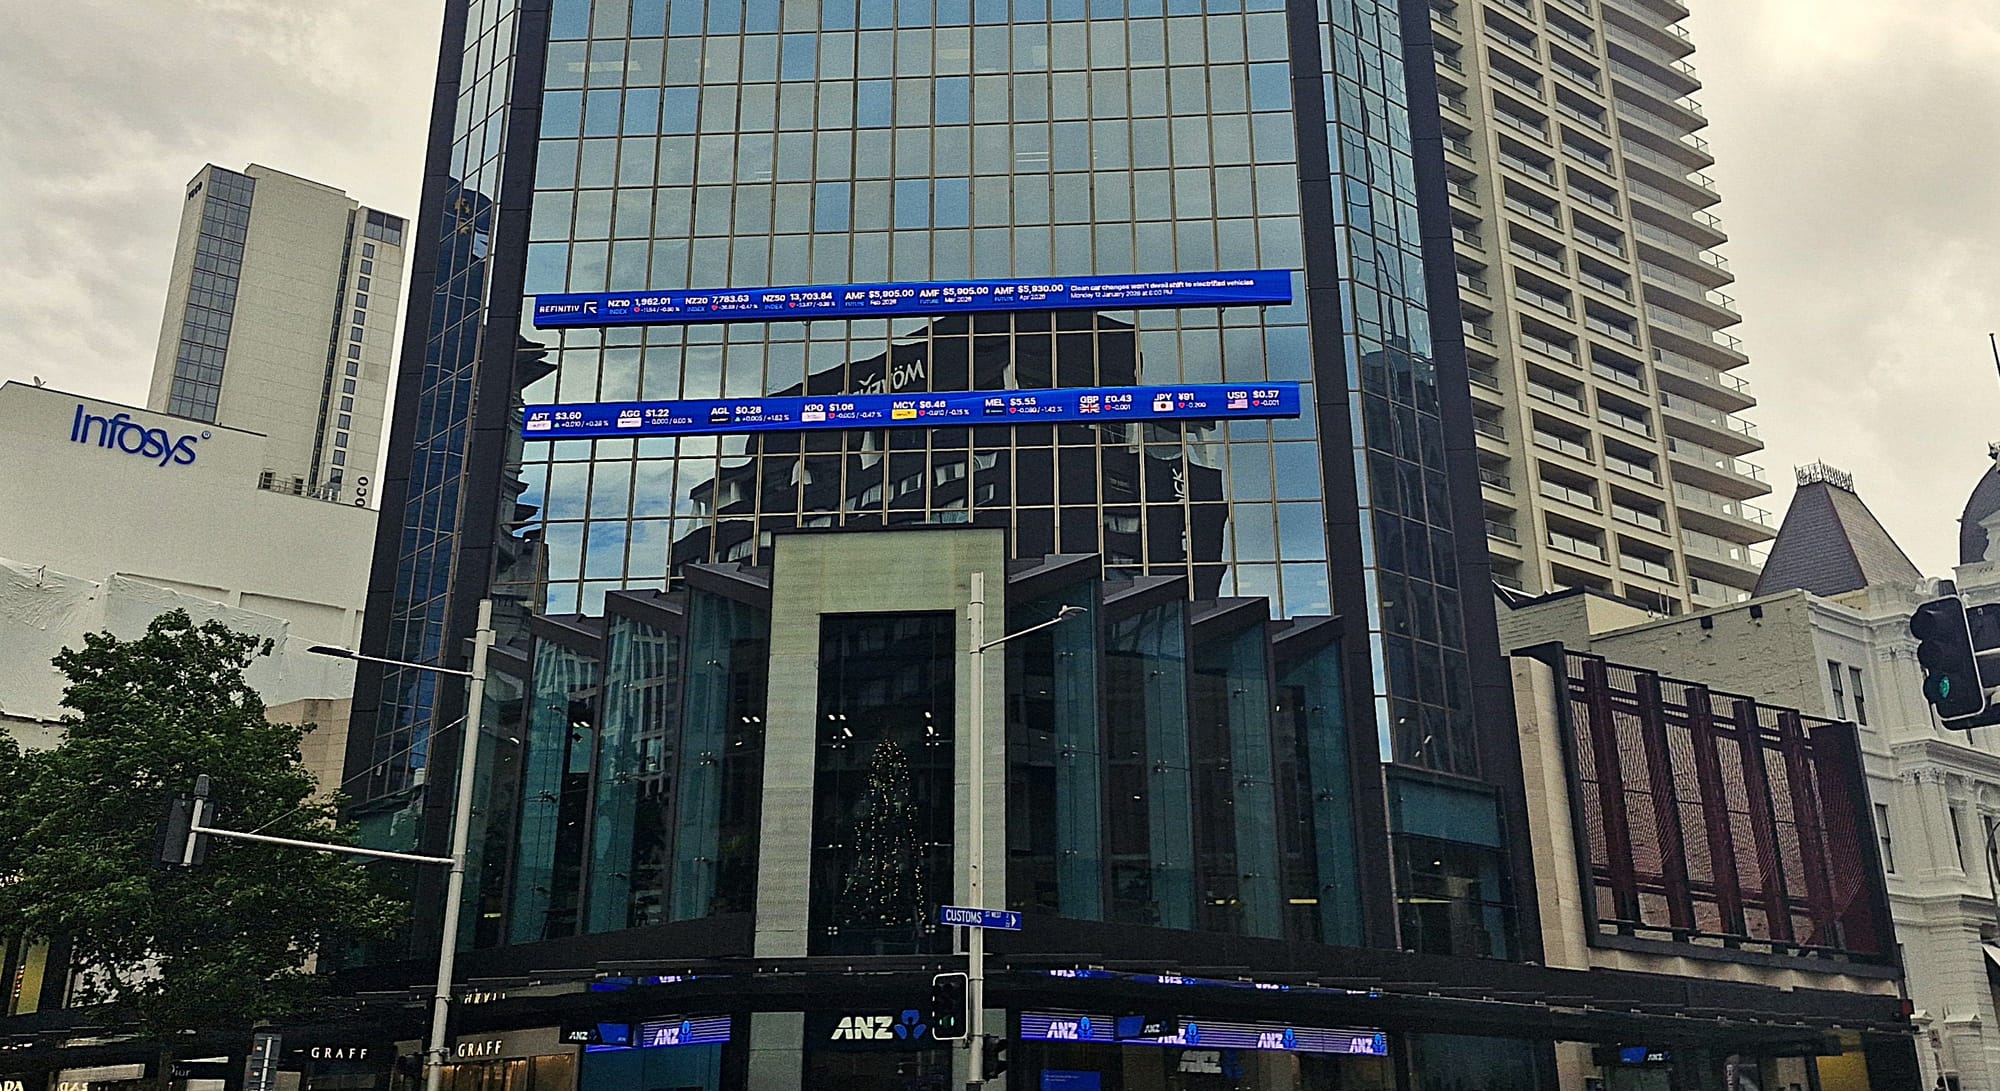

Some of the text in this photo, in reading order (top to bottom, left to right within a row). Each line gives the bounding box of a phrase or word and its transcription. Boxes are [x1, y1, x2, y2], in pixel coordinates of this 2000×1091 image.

[845, 289, 915, 300] AMF $5,905.00
[919, 286, 989, 298] AMF $5,905.00
[994, 284, 1064, 295] AMF $5,930.00
[685, 295, 750, 305] NZ20 7,783.63
[762, 292, 833, 303] NZ50 13,703.84
[539, 304, 580, 313] REFINITIV
[607, 299, 630, 308] NZ10
[1080, 394, 1133, 404] GBP £0.43
[1154, 393, 1172, 401] JPY
[1227, 390, 1280, 399] USD $0.57
[893, 401, 915, 409] MCY
[1010, 398, 1036, 406] $5.55
[531, 411, 582, 420] AFT $3.60
[619, 409, 670, 418] AGG $1.22
[711, 406, 762, 415] AGL $0.28
[71, 404, 198, 467] Infosys
[945, 909, 983, 924] CUSTOMS
[831, 1016, 893, 1040] ANZ
[1046, 1021, 1079, 1040] ANZ
[1144, 1023, 1161, 1033] ANZ
[569, 1031, 589, 1041] ANZ
[654, 1028, 680, 1046] ANZ
[1257, 1032, 1284, 1049] ANZ
[457, 1040, 503, 1058] GRAFF
[1350, 1037, 1373, 1053] ANZ
[311, 1047, 368, 1060] GRAFF
